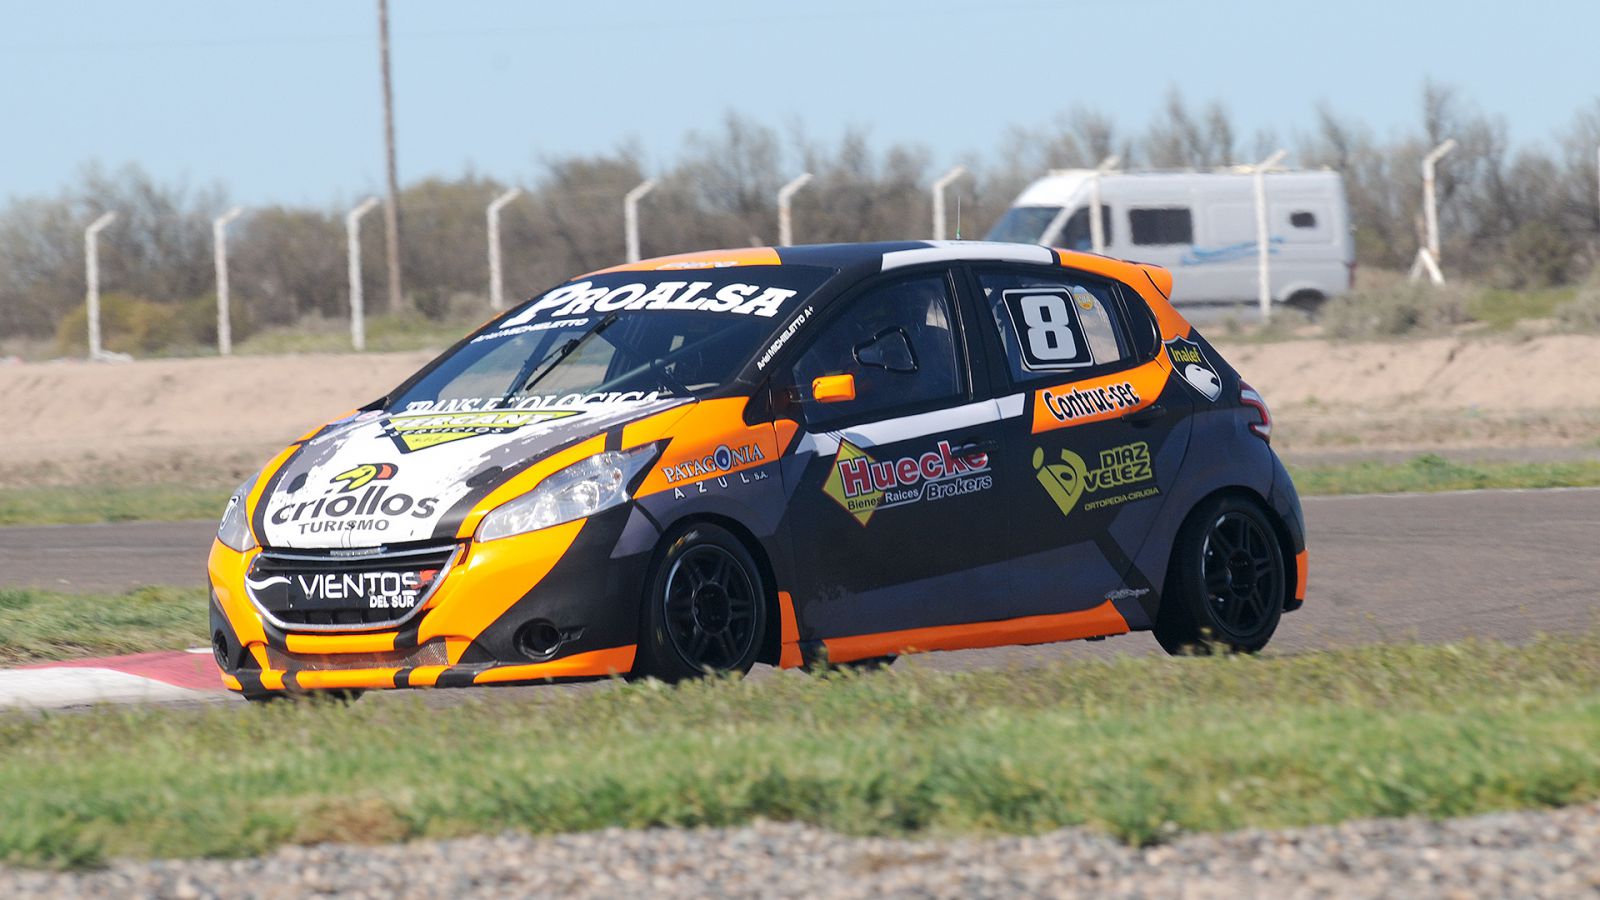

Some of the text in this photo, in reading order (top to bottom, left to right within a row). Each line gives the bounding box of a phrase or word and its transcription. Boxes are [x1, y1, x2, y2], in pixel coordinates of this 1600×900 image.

[499, 281, 797, 329] PROALSA
[1020, 295, 1077, 360] 8
[1042, 382, 1141, 422] Contruc-sec
[662, 443, 765, 483] PATAGONIA
[1100, 441, 1150, 469] DIAZ
[885, 489, 919, 503] Raices
[927, 475, 992, 500] Brokers
[1083, 461, 1152, 492] VELEZ
[271, 486, 439, 525] criollos
[298, 518, 390, 535] TURISMO
[298, 571, 418, 599] VIENTOS
[369, 594, 415, 609] DEL SUR
